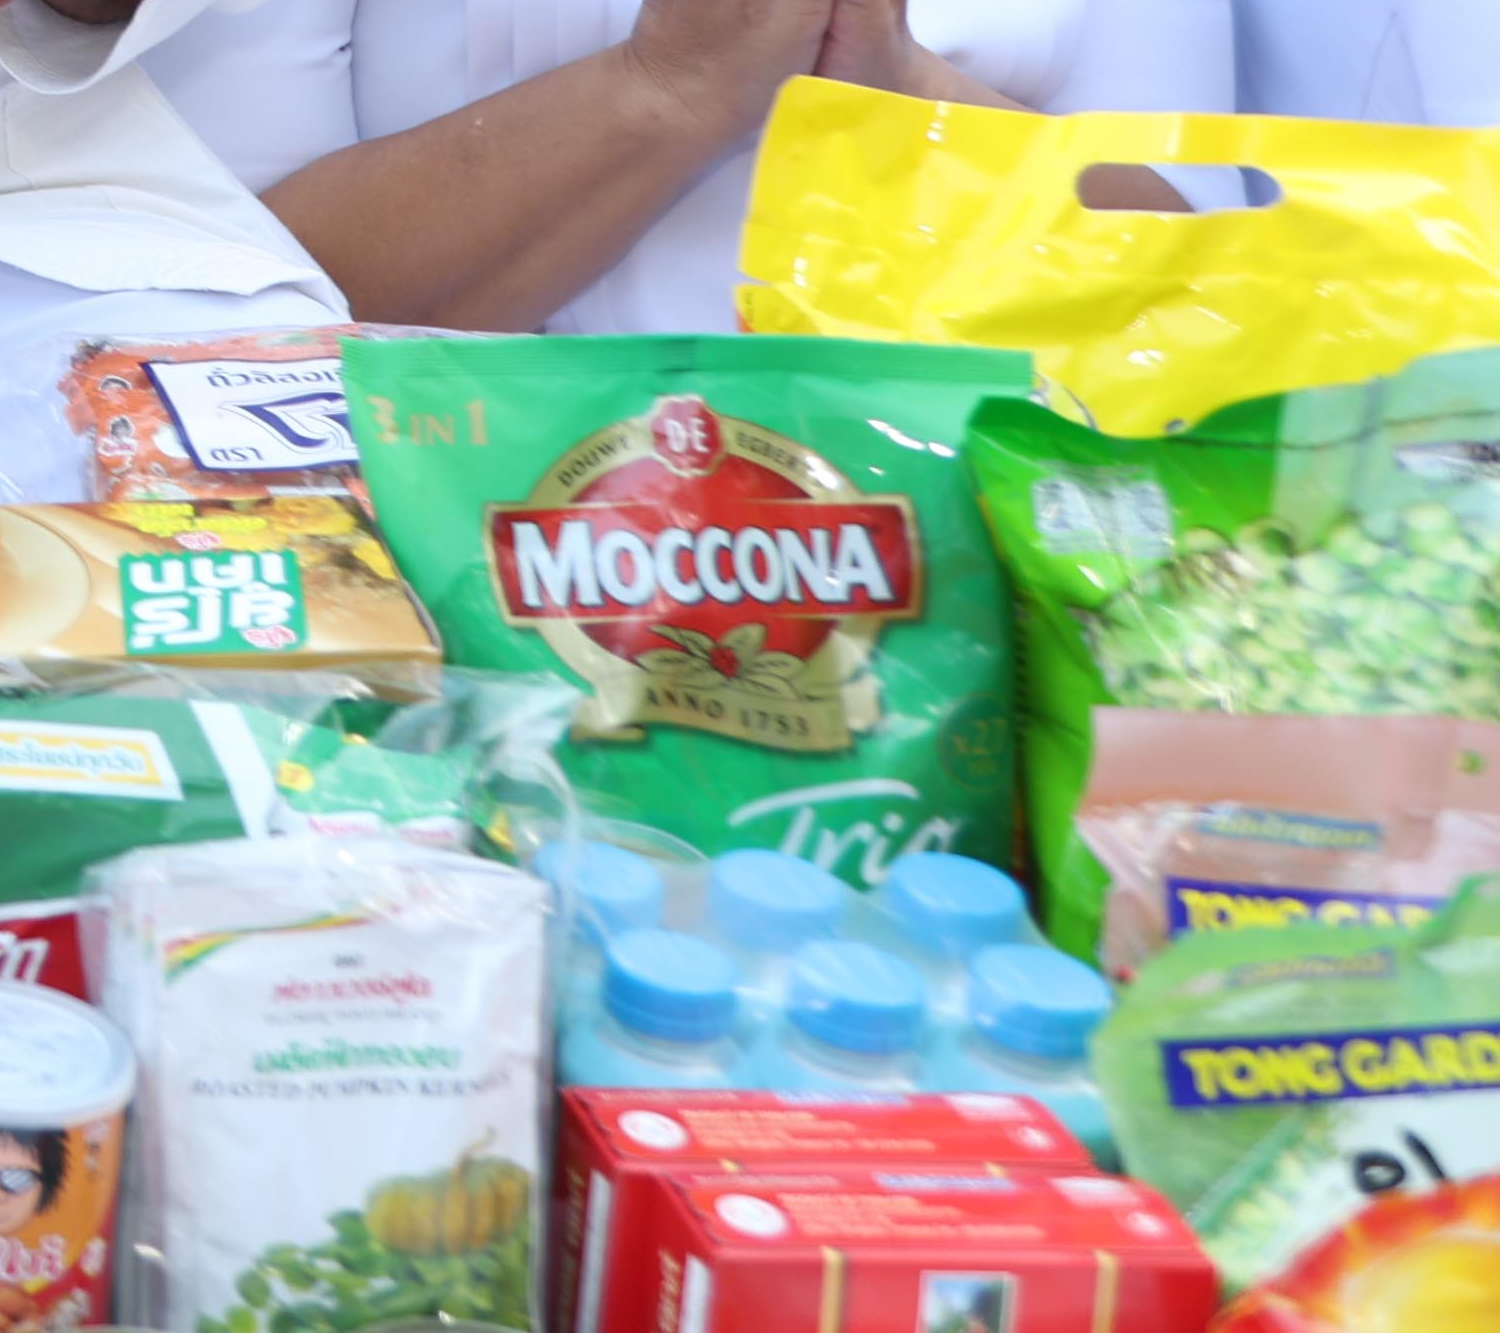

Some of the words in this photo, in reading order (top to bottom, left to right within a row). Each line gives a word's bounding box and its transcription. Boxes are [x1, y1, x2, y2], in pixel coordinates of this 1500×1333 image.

[367, 396, 397, 444] 3
[410, 413, 455, 445] IN
[465, 398, 490, 446] 1
[211, 447, 264, 462] ตรา
[511, 520, 894, 608] MOCCONA
[645, 686, 726, 720] ANNO
[739, 706, 810, 733] 1753
[728, 778, 962, 891] Trio
[1180, 1041, 1343, 1100] TONG
